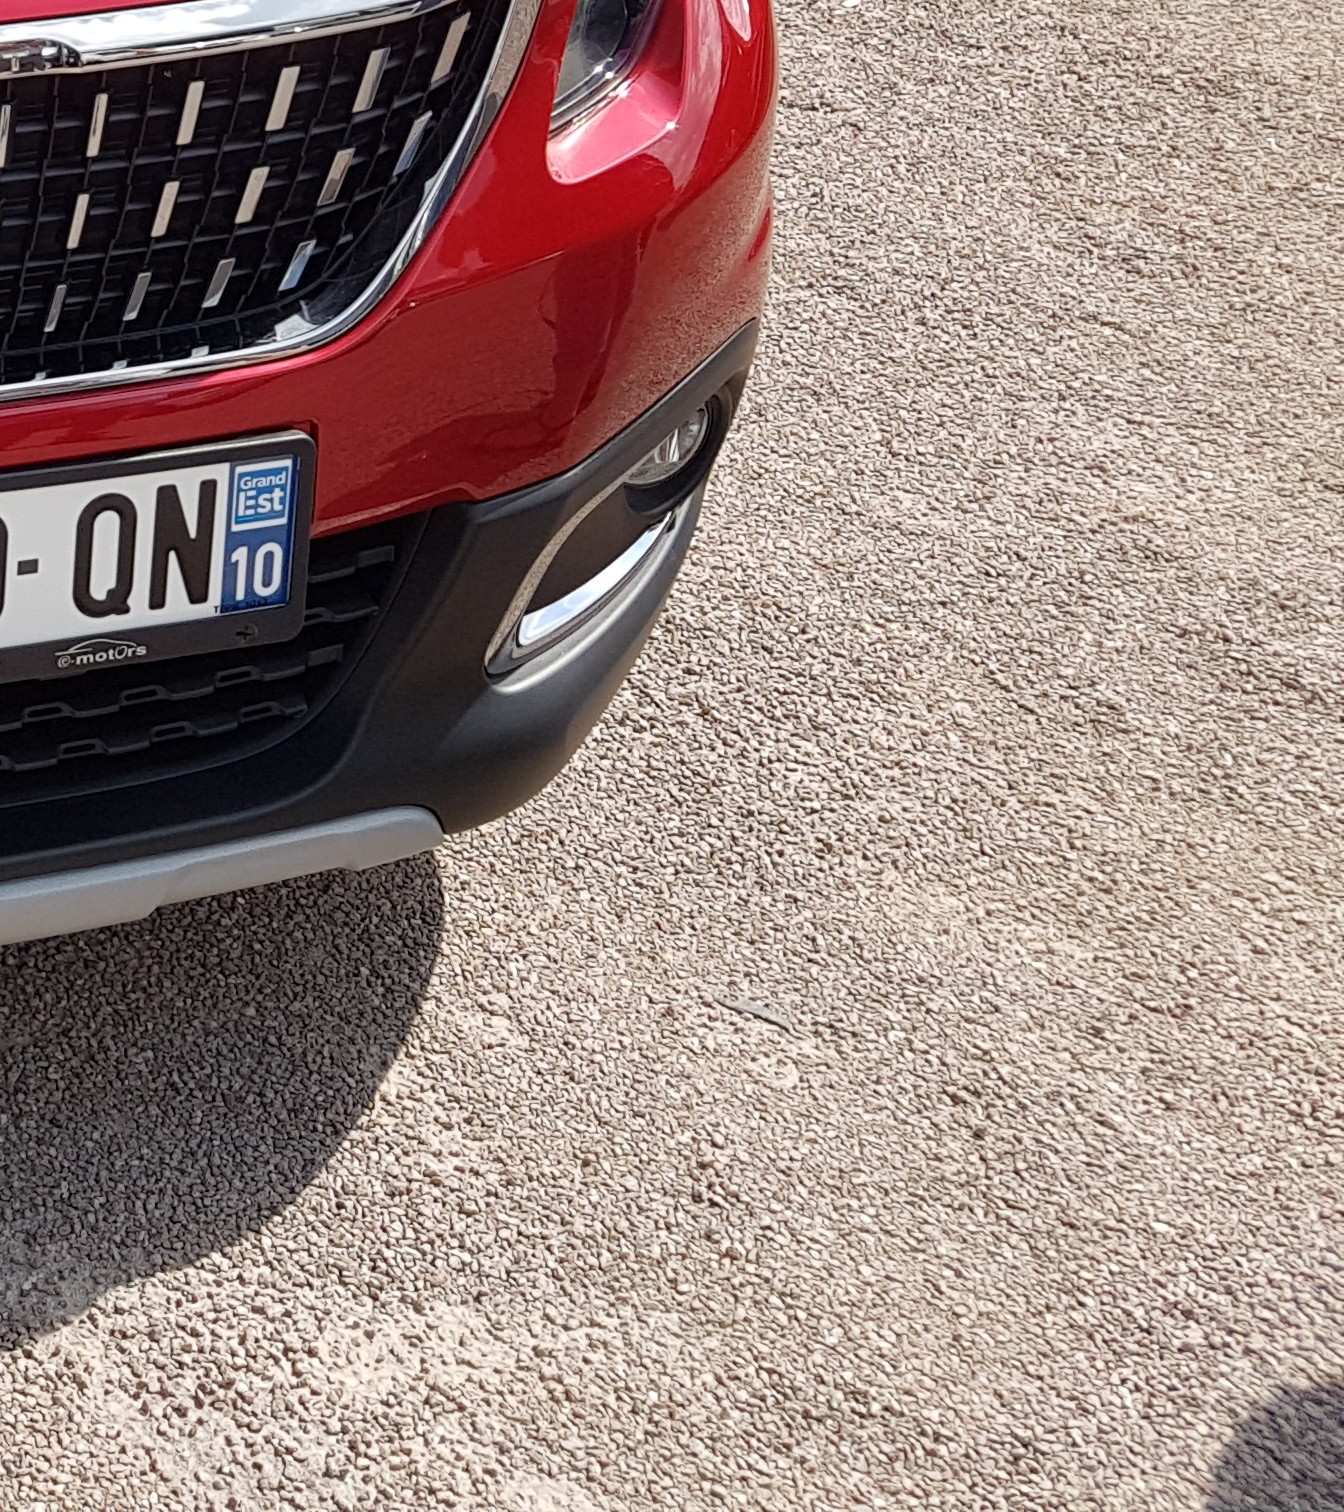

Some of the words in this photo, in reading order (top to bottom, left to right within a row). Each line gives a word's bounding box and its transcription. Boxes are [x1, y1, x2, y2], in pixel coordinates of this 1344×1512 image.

[240, 471, 286, 489] Grand
[238, 488, 285, 516] Est
[231, 541, 284, 601] 10
